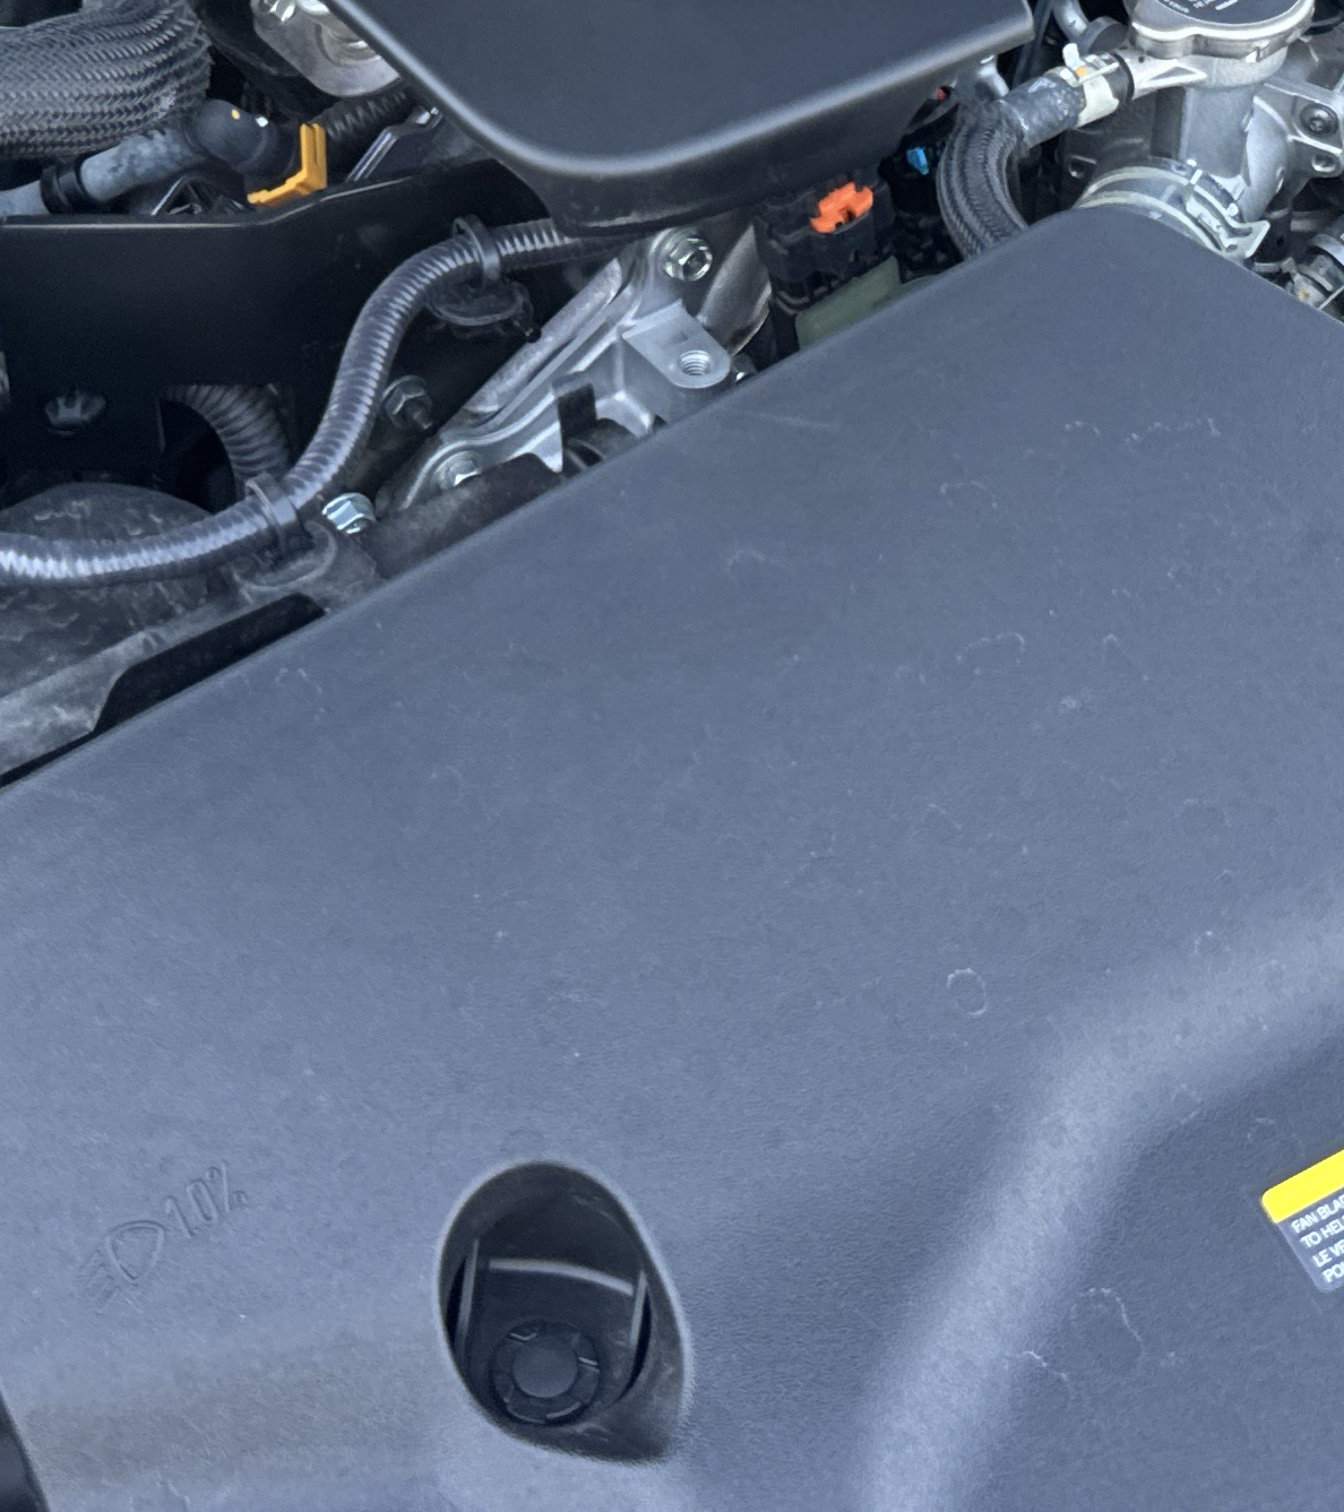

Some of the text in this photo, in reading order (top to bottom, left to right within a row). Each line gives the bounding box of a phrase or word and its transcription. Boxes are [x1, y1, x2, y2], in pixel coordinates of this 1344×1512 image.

[1291, 1211, 1319, 1233] FAN
[1300, 1230, 1323, 1250] TO
[1313, 1249, 1333, 1267] LE
